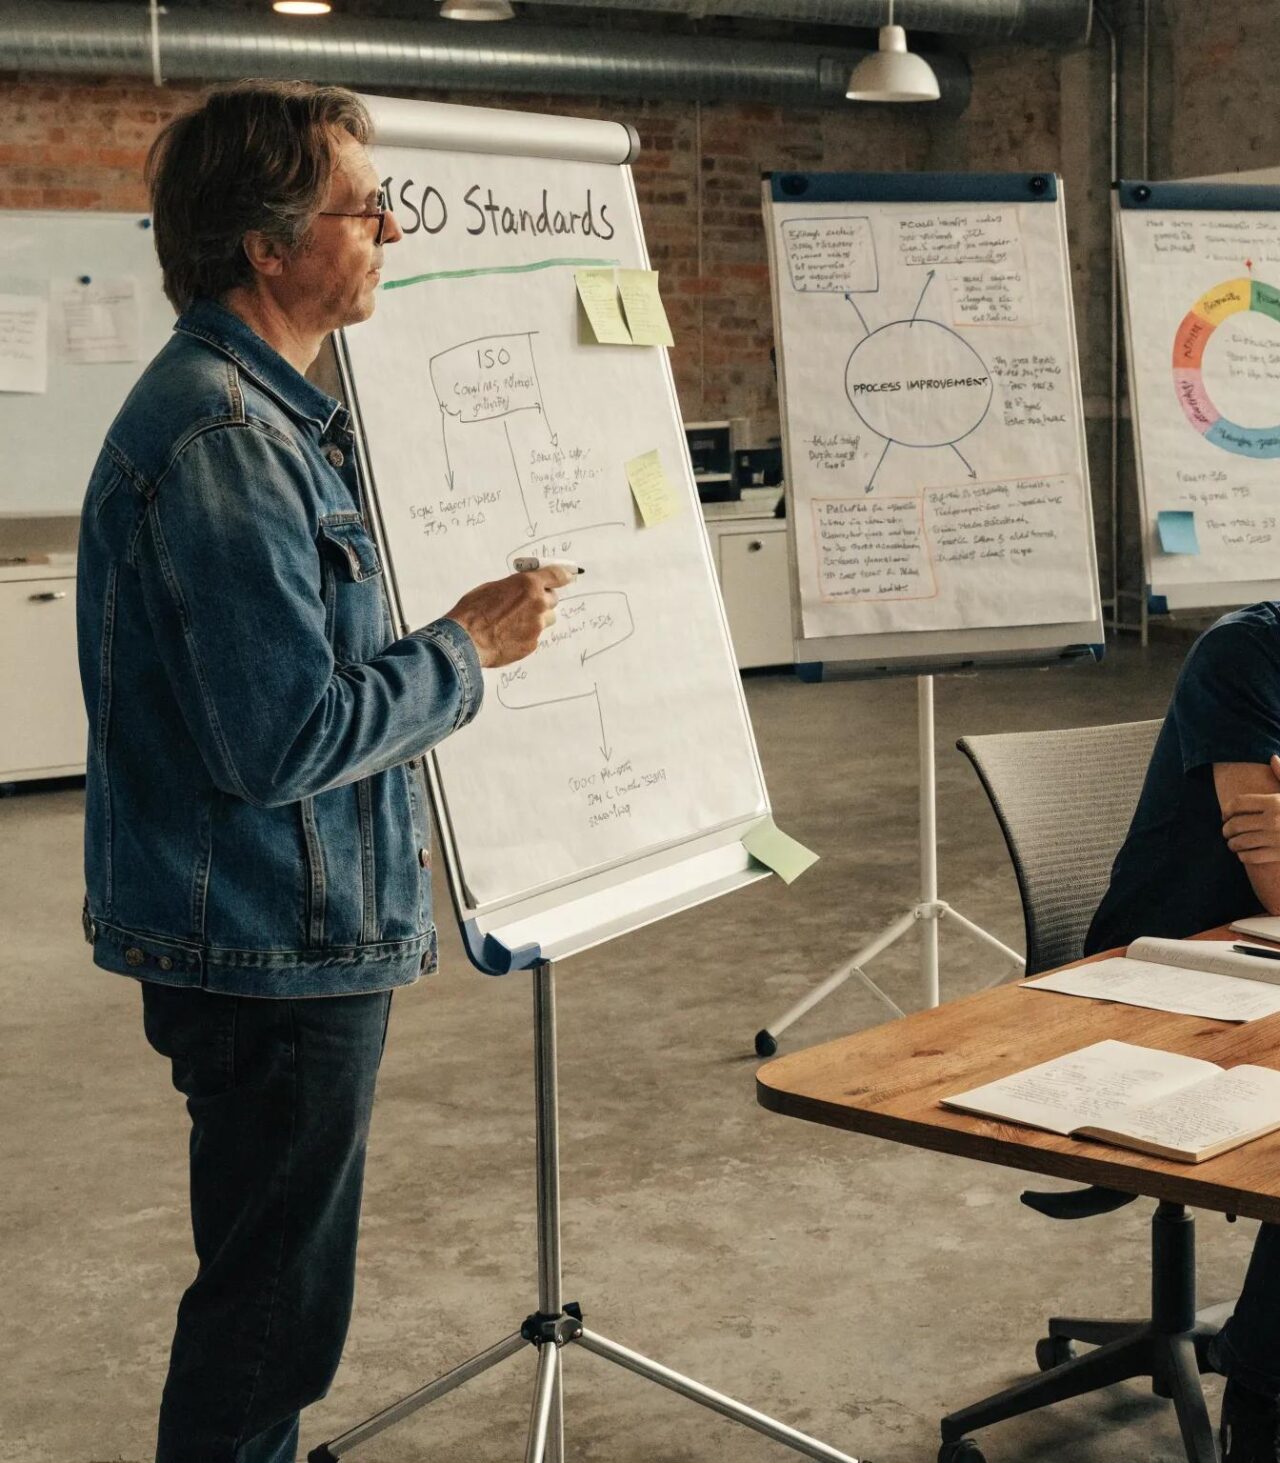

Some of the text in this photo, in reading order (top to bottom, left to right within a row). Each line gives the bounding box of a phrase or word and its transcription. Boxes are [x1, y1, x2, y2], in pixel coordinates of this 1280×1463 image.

[381, 176, 615, 241] ISO Standards
[476, 347, 511, 369] ISO
[906, 376, 988, 391] IMPROVEMENT
